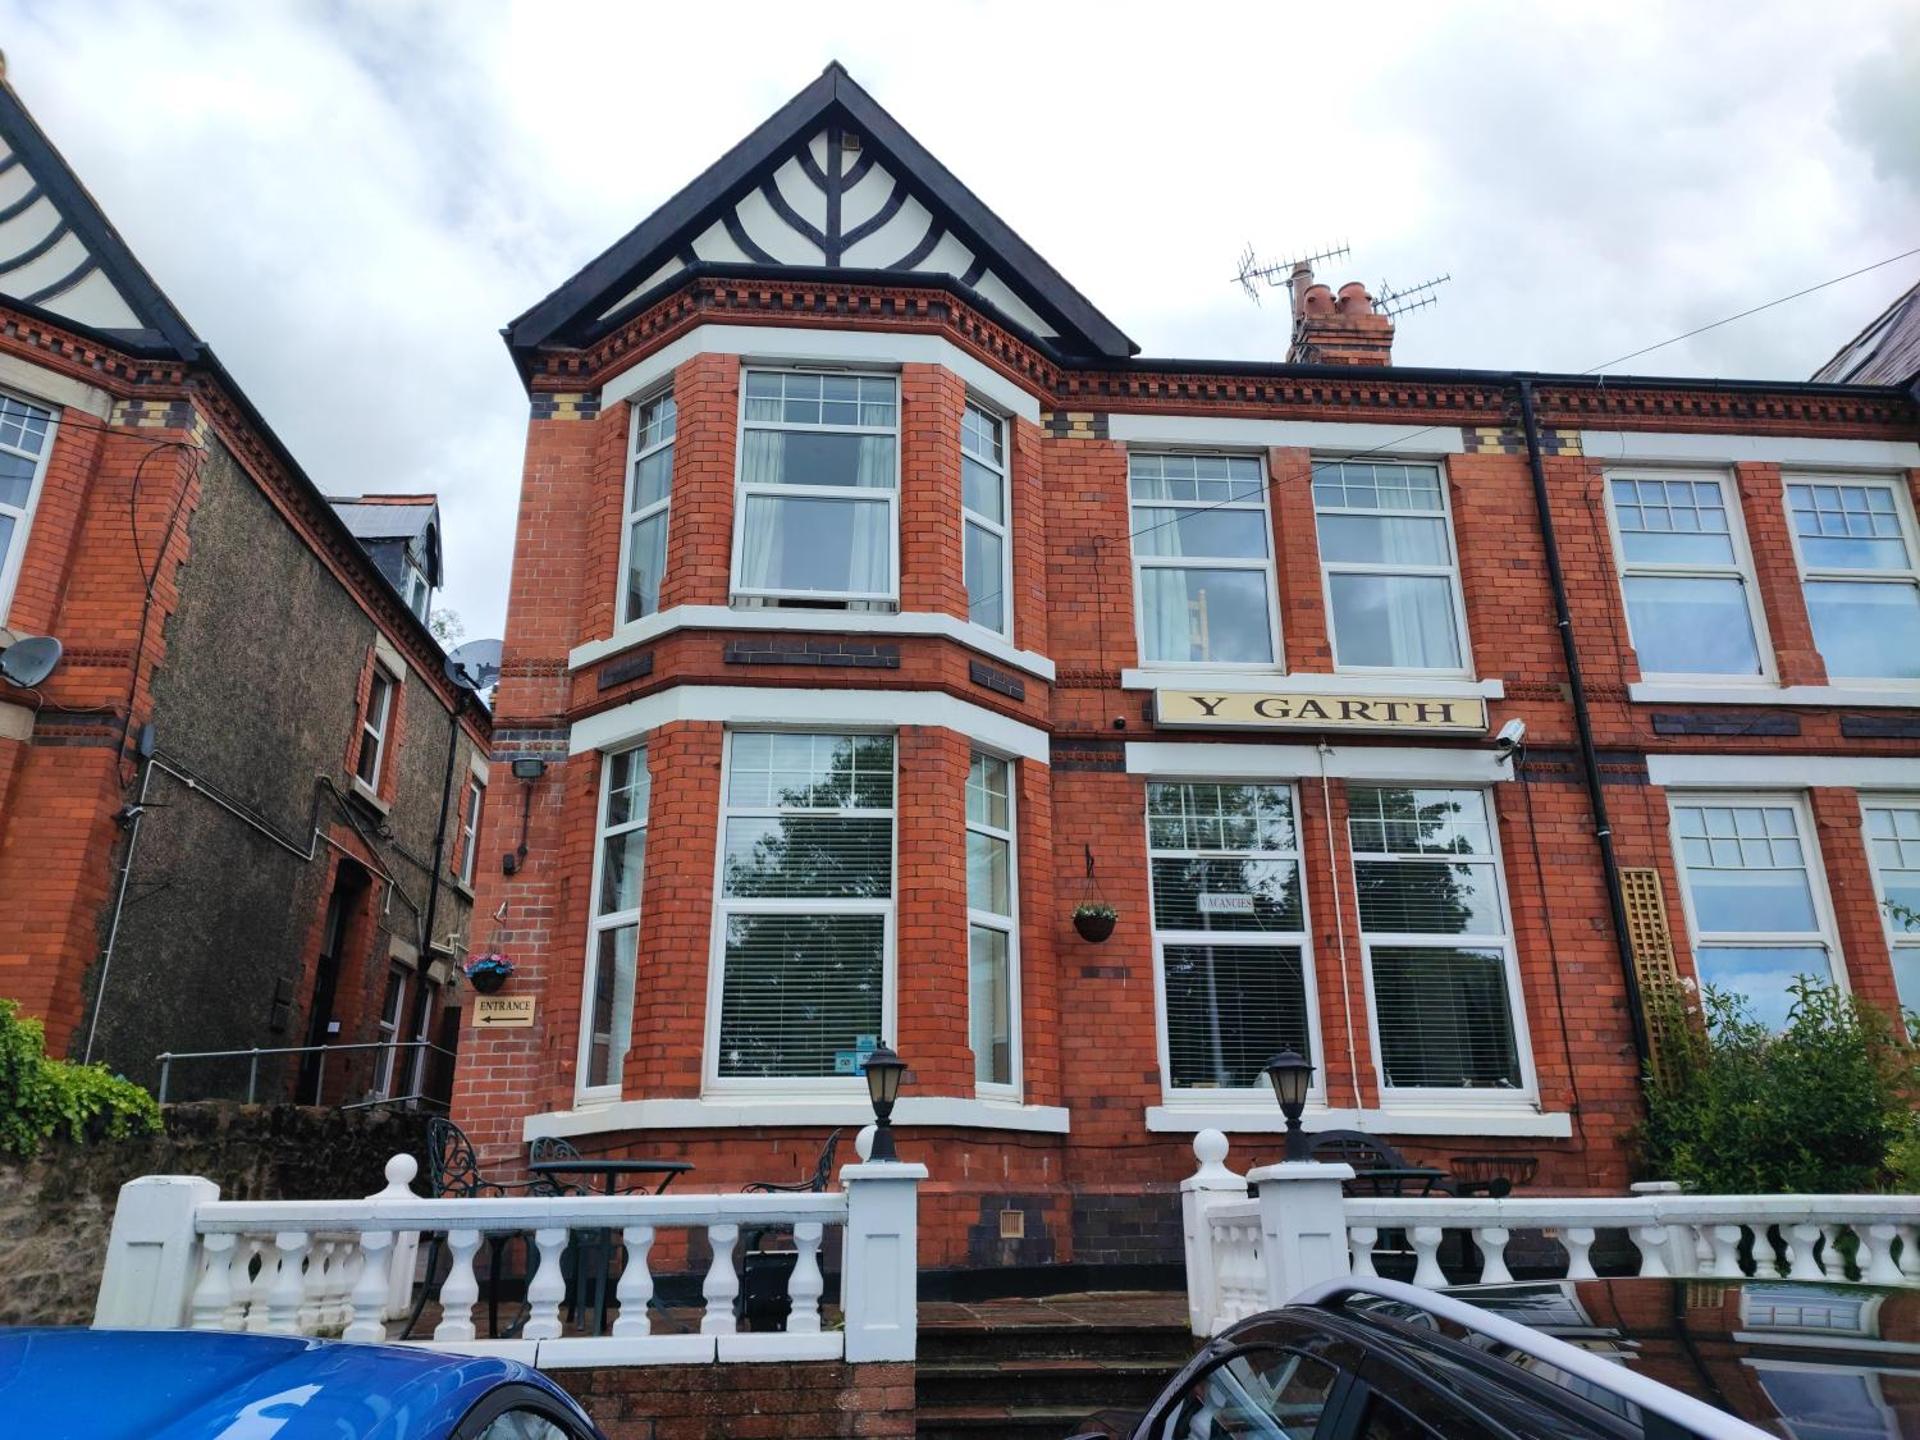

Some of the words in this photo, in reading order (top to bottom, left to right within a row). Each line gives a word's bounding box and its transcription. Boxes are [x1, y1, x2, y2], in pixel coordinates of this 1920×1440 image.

[1188, 696, 1227, 716] Y
[1253, 698, 1455, 723] GARTH
[1201, 896, 1253, 908] VACANCIES
[480, 1001, 530, 1011] ENTRANCE
